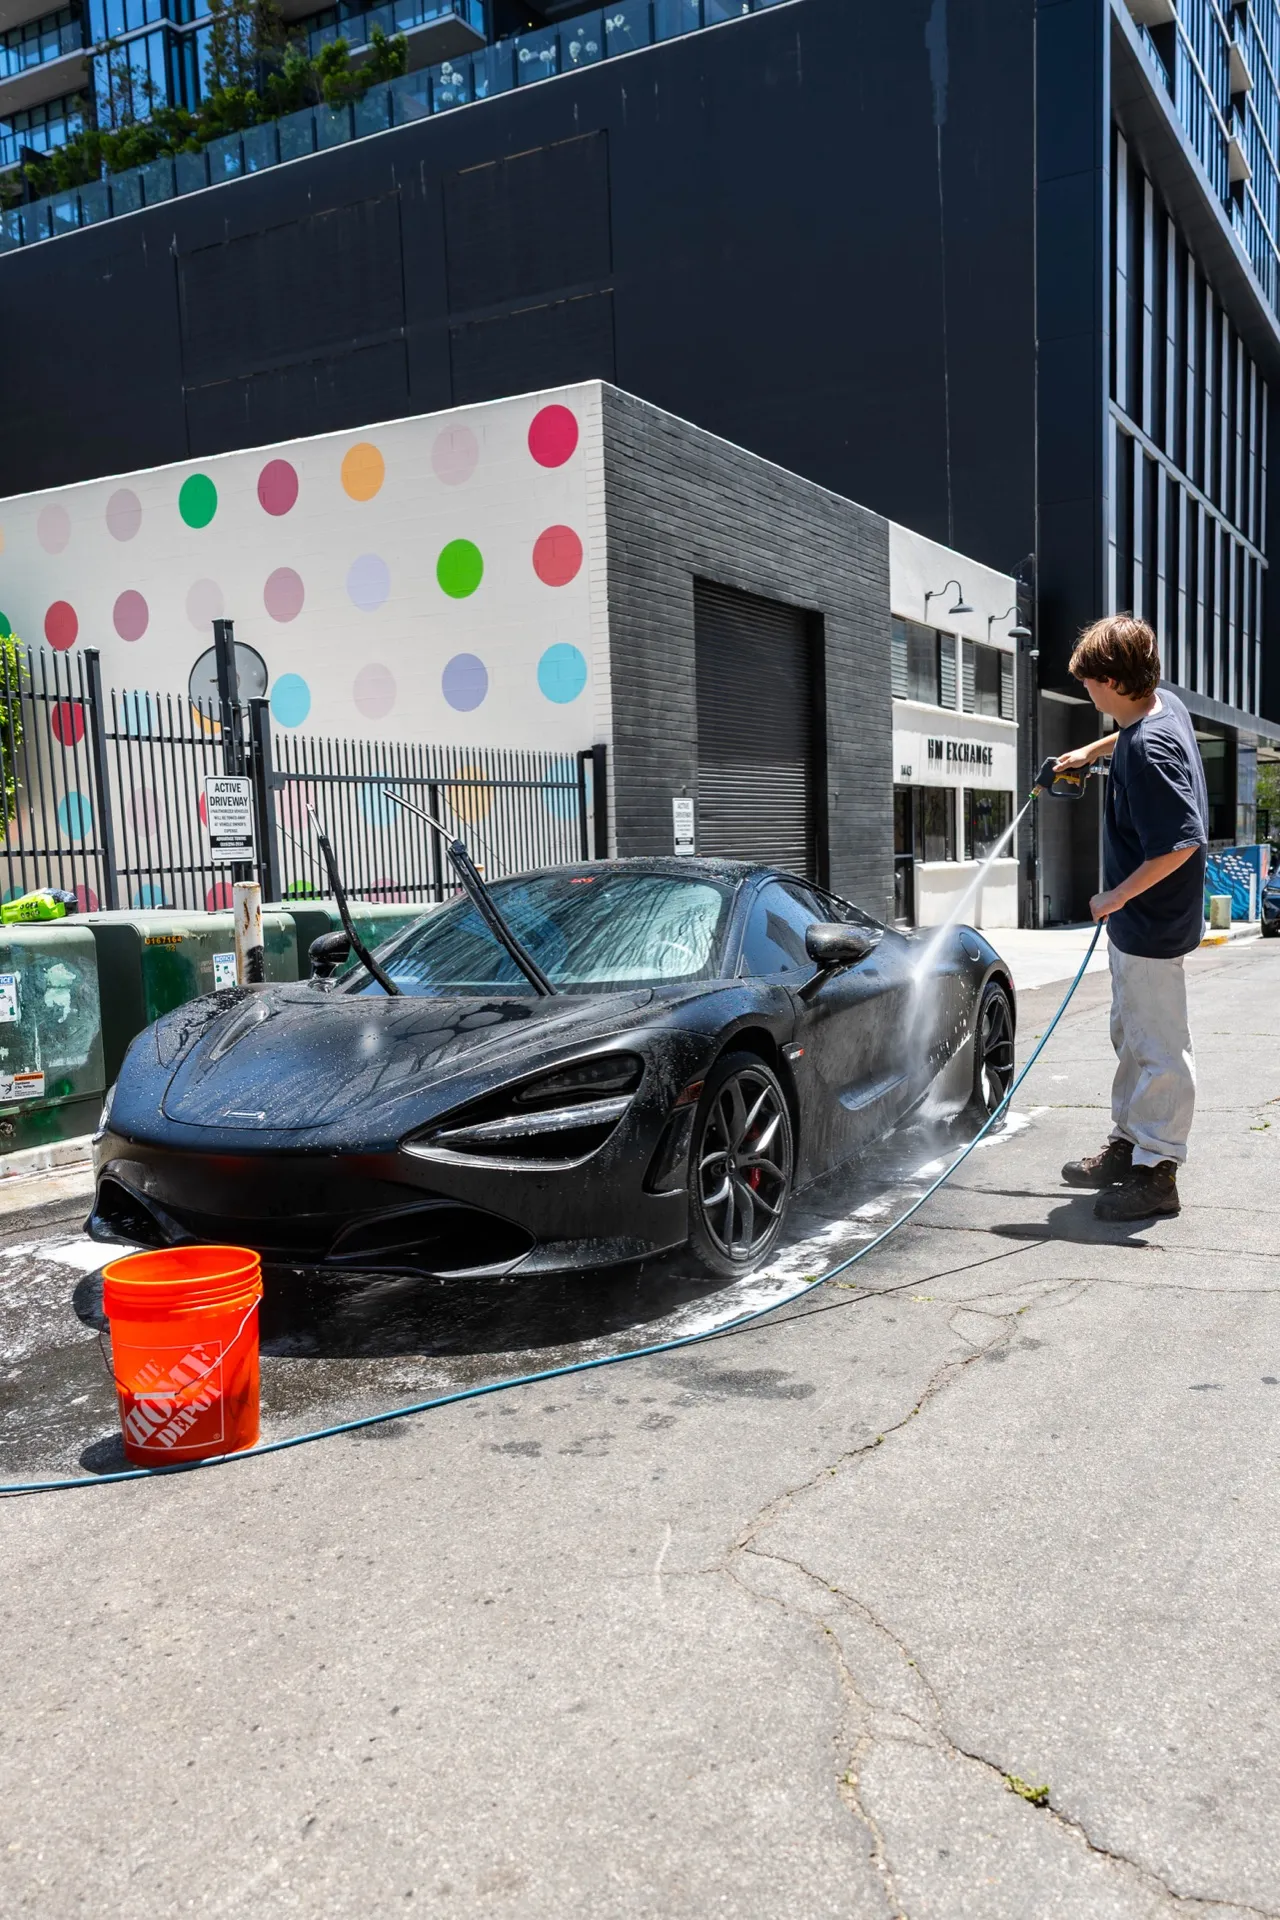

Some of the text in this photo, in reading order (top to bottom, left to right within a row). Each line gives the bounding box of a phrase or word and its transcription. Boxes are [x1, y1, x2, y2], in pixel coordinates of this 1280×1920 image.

[946, 741, 993, 765] EXCHANGE
[214, 782, 242, 793] ACTIVE
[209, 796, 248, 807] DRIVEWAY
[129, 1358, 165, 1389] THE
[125, 1344, 222, 1446] HOME
[155, 1381, 222, 1448] DEPOT
